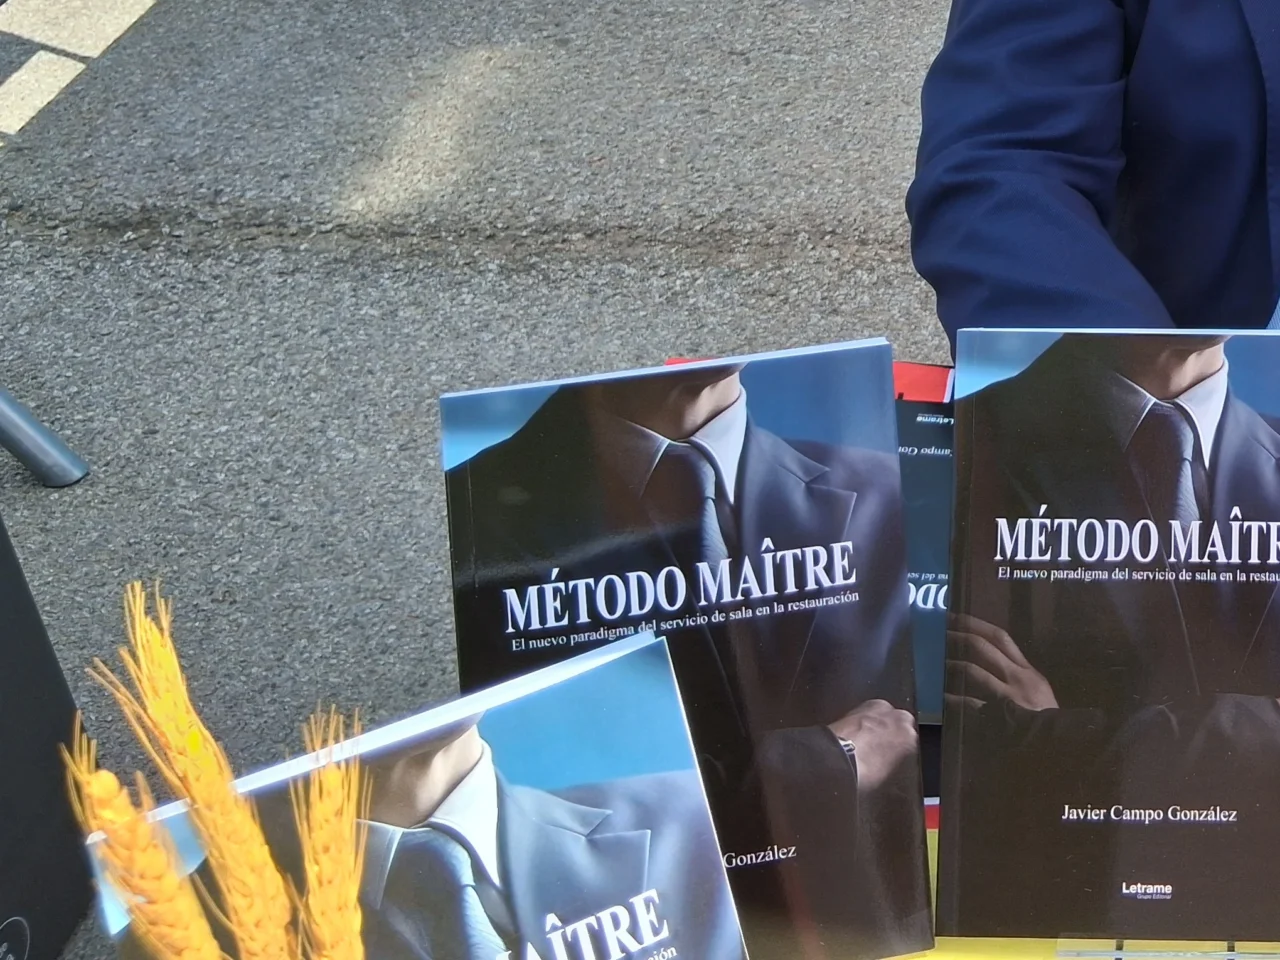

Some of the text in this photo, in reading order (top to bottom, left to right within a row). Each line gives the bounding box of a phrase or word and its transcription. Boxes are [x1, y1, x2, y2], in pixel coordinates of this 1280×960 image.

[994, 504, 1159, 563] MÉTODO
[503, 537, 857, 633] MÉTODO MAÎTRE
[998, 566, 1010, 579] El
[1013, 569, 1048, 580] nuevo
[1050, 567, 1108, 582] paradigma
[1112, 567, 1129, 581] del
[1132, 568, 1176, 581] servicio
[1179, 569, 1192, 581] de
[1195, 569, 1217, 581] sala
[1219, 572, 1233, 582] en
[1236, 569, 1247, 582] la
[512, 591, 860, 651] El nuevo paradigma del servicio de sala en la restauración
[1062, 804, 1238, 824] Javier Campo González
[723, 843, 797, 869] González
[1122, 882, 1172, 894] Letrame
